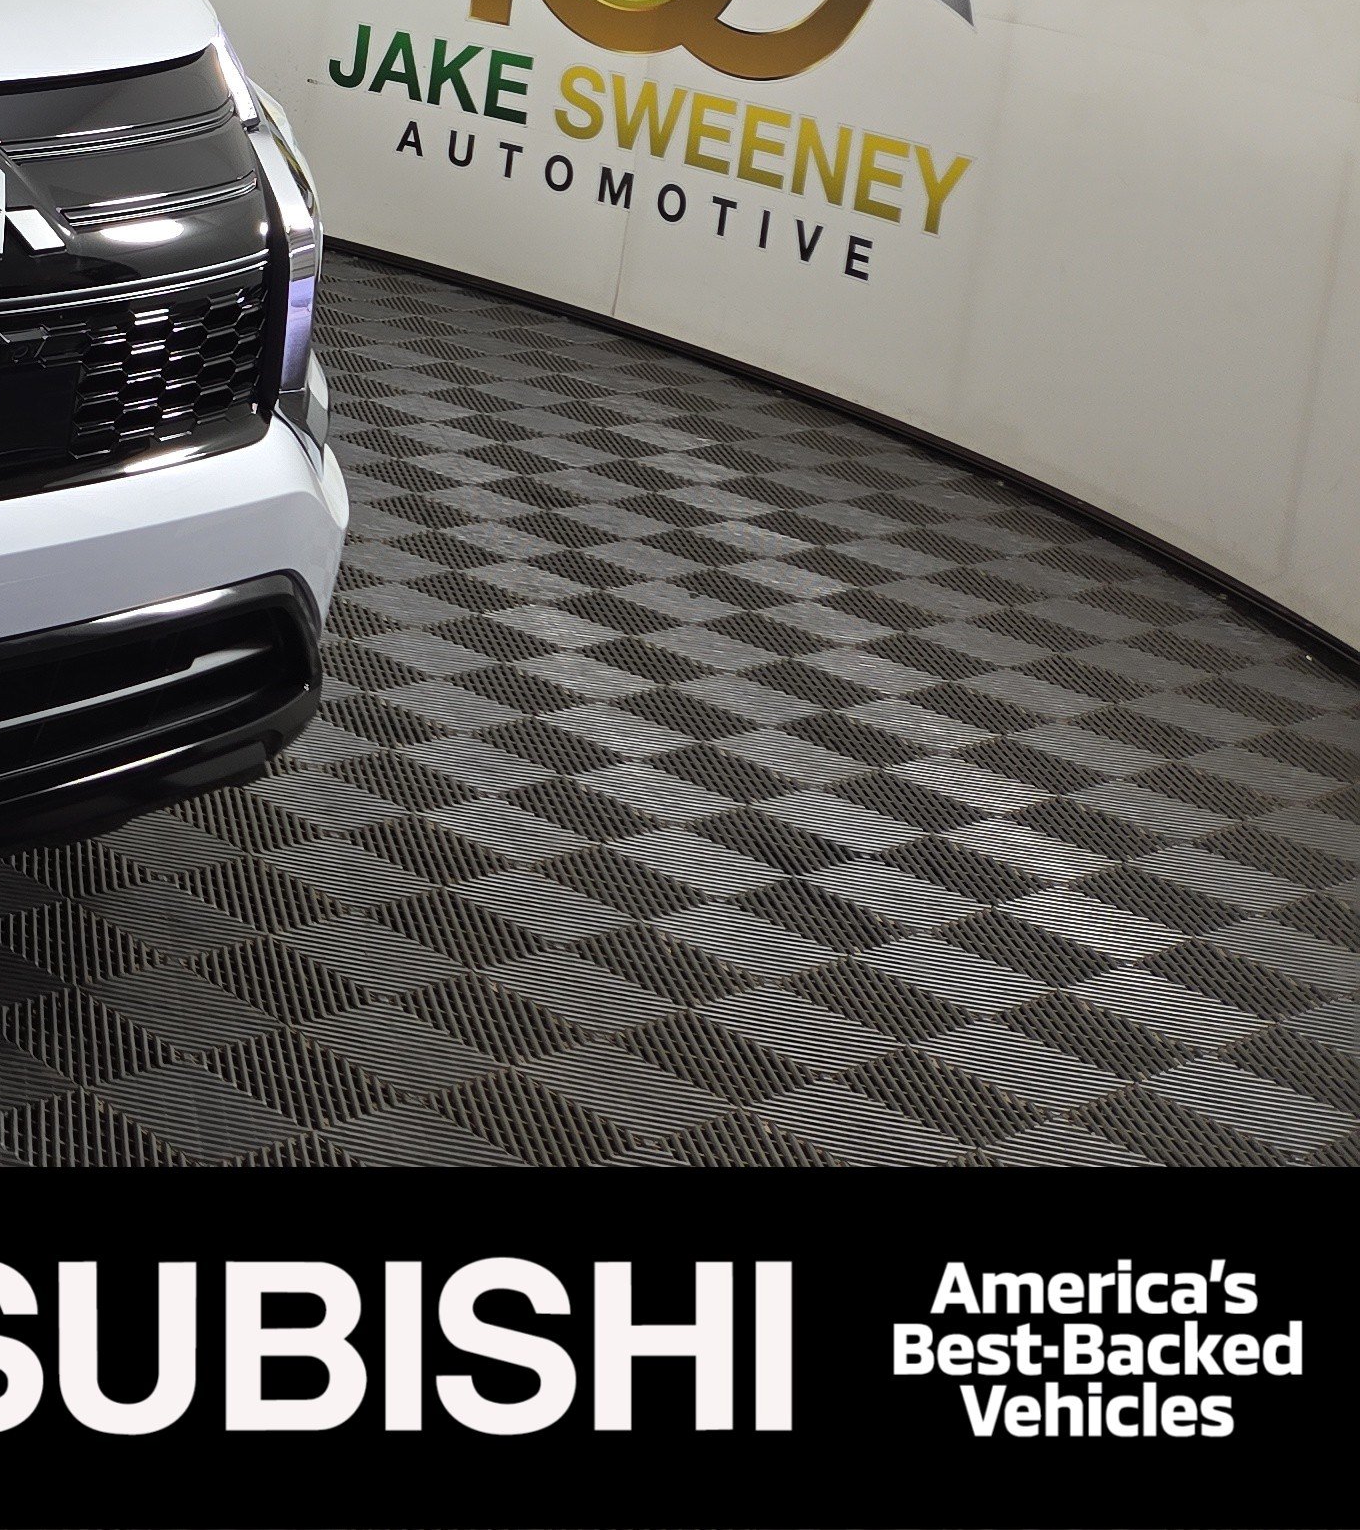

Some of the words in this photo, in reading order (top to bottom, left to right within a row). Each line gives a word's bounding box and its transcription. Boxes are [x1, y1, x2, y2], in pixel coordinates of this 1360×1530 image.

[328, 24, 534, 125] JAKE
[554, 65, 972, 235] SWEENEY
[396, 120, 873, 281] AUTOMOTIVE
